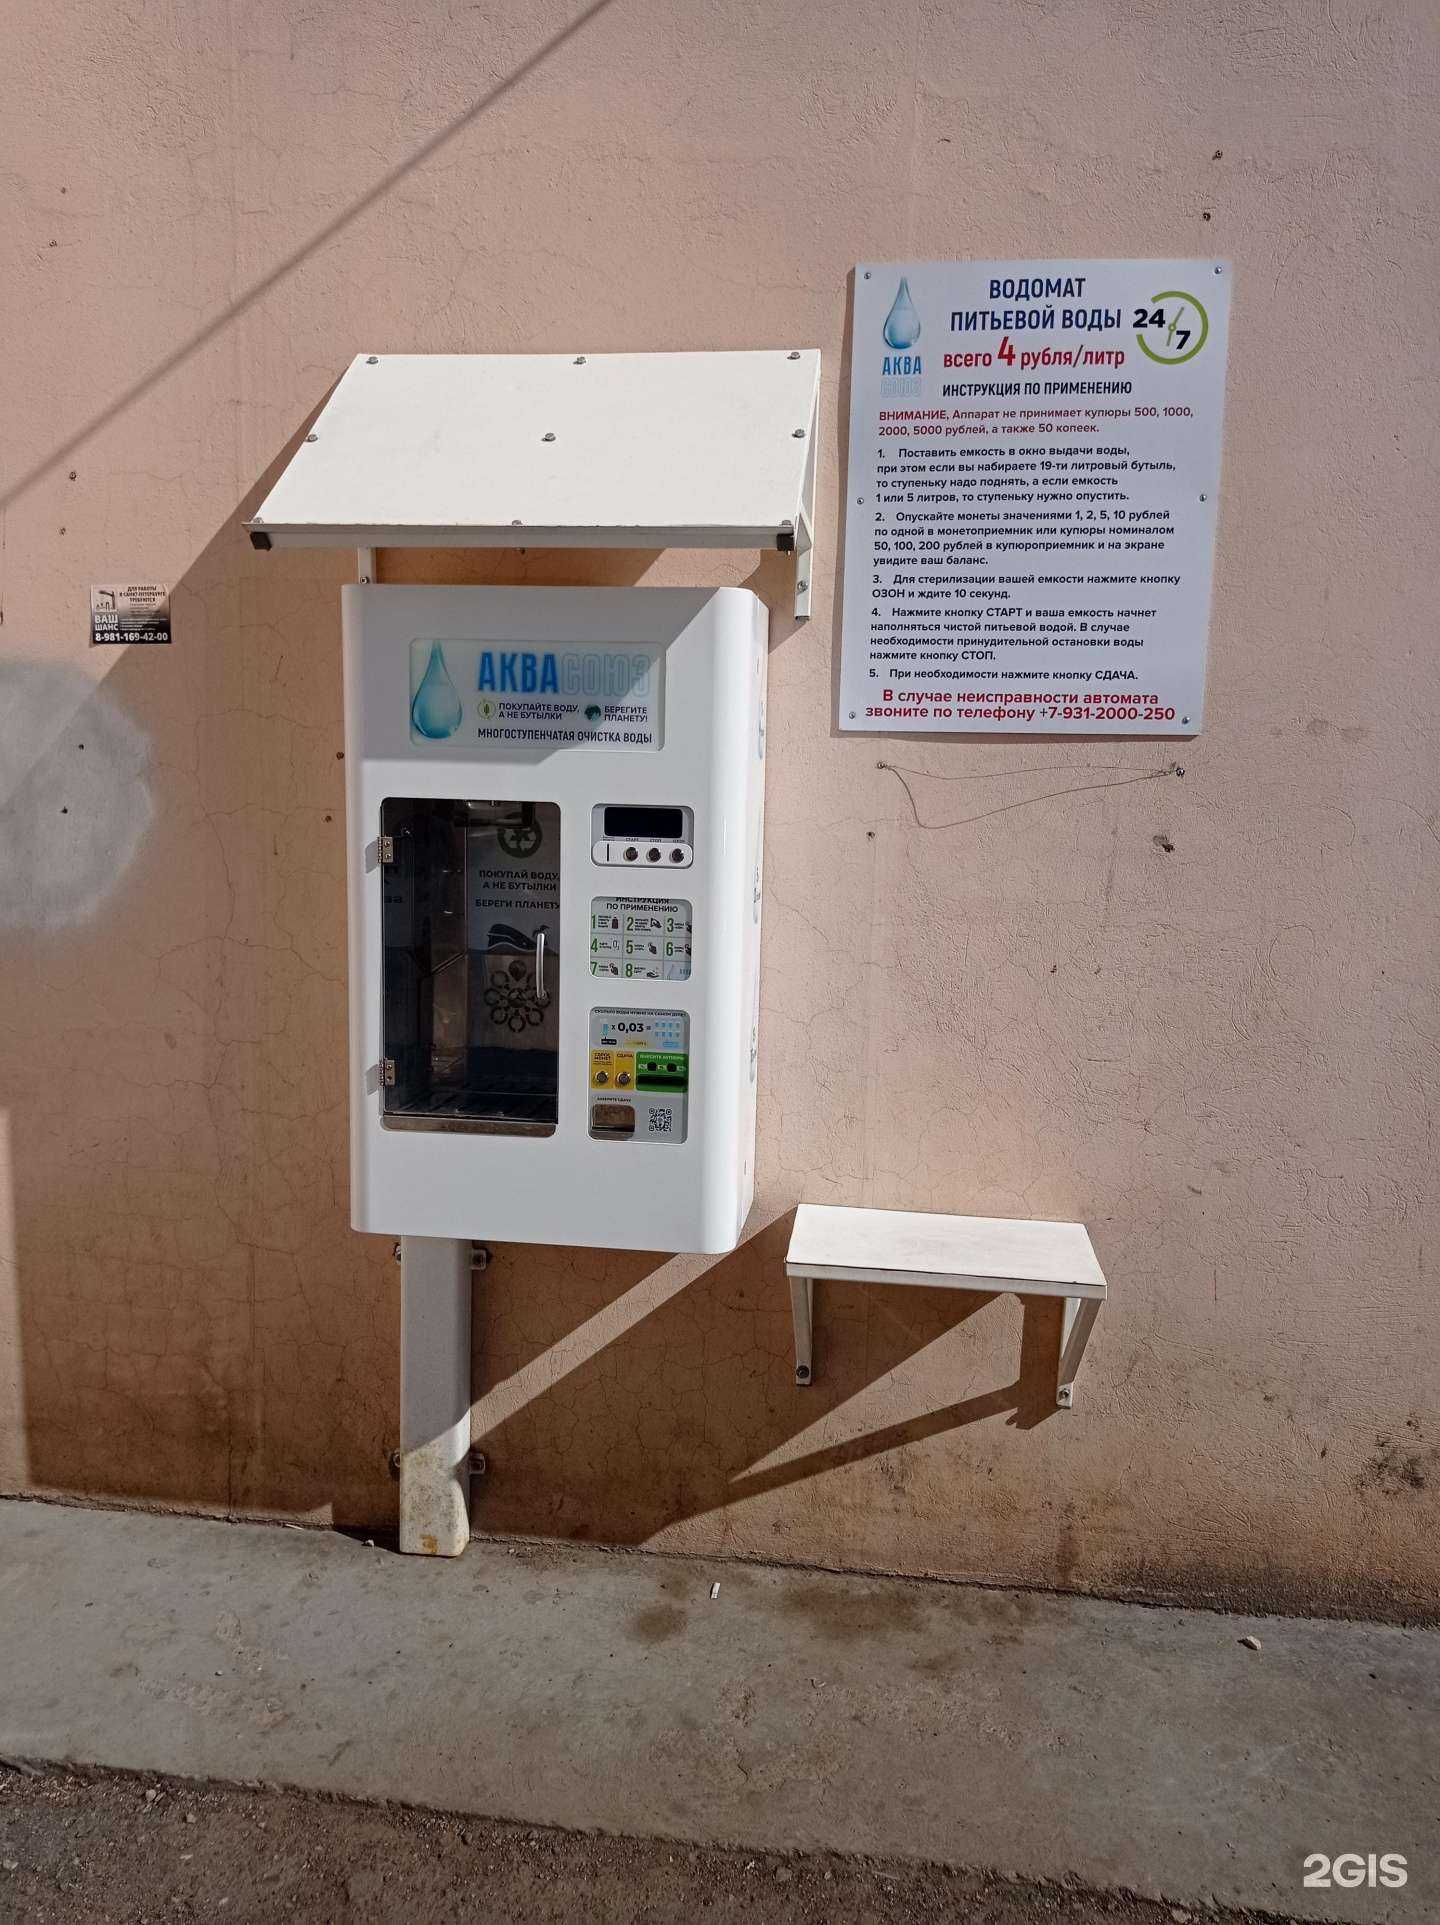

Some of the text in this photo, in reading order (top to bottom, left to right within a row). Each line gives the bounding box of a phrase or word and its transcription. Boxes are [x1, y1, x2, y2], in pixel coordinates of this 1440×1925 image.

[989, 277, 1086, 301] ВОДОМАТ
[950, 305, 1121, 331] ПИТЬЕВОЙ ВОДЫ
[1132, 309, 1190, 350] 24 7
[943, 336, 1124, 370] всего 4 рубля/литр
[882, 356, 922, 376] АКВА
[942, 381, 1132, 397] ИНСТРУКЦИЯ ПО ПРИМЕНЕНИЮ
[879, 406, 1193, 420] ВНИМАНИЕ, Аппарат не принимает купюры 500, 1000,
[878, 423, 1099, 437] 2000, 5000 рублей, также 50 копеек.
[898, 447, 1129, 457] Поставить емкость окно выдачи воды,
[877, 465, 897, 475] при
[928, 464, 955, 472] если
[977, 461, 1037, 473] набираете
[1039, 460, 1067, 470] 19-ти
[1070, 460, 1127, 472] литровый
[1130, 460, 1175, 472] бутыль,
[876, 477, 1118, 489] то ступеньку надо поднять, если емкость
[916, 494, 958, 503] литров,
[976, 493, 1034, 503] ступеньку
[1036, 493, 1073, 502] нужно
[1075, 492, 1129, 502] опустить.
[896, 511, 954, 523] Опускайте
[1002, 512, 1072, 520] значениями
[1113, 510, 1125, 519] 10
[1128, 510, 1169, 521] рублей
[874, 528, 887, 536] по
[890, 526, 924, 537] одной
[937, 527, 1033, 537] монетоприемник
[1060, 527, 1105, 536] купюры
[874, 541, 890, 551] 50,
[893, 540, 915, 551] 100,
[918, 540, 940, 550] 200
[942, 540, 982, 552] рублей
[995, 542, 1094, 552] купюроприемник
[1124, 541, 1164, 551] экране
[873, 557, 917, 567] увидите
[946, 555, 988, 564] баланс.
[893, 574, 1180, 585] Для стерилизации вашей емкости нажмите кнопку
[872, 588, 1010, 600] ОЗОН ждите 10 секунд.
[95, 615, 118, 623] ВАШ
[891, 607, 1156, 619] Нажмите кнопку СТАРТ ваша емкость начнет
[871, 622, 1129, 633] наполняться чистой питьевой водой. случае
[96, 632, 168, 641] 8-981-169-42-00
[870, 635, 1143, 647] необходимости принудительной остановки воды
[920, 652, 958, 662] кнопку
[961, 650, 995, 660] СТОП.
[889, 668, 1138, 681] При необходимости нажмите кнопку СДАЧА.
[898, 692, 1158, 705] случае неисправности автомата
[498, 702, 552, 712] ПОКУПАЙТЕ
[604, 706, 647, 714] БЕРЕГИТЕ
[520, 712, 562, 720] БУТЫЛКИ
[604, 714, 648, 723] ПЛАНЕТУ!
[865, 706, 1175, 721] звоните по телефону +7-931-2000-250
[478, 729, 652, 744] МНОГОСТУПЕНЧАТАЯ ОЧИСТКА ВОДЫ
[480, 870, 528, 879] ПОКУПАЙ
[508, 882, 556, 890] БУТЫЛКИ
[475, 899, 512, 908] БЕРЕГИ
[621, 904, 678, 912] ПРИМЕНЕНИЮ
[591, 914, 596, 929] 1
[627, 917, 634, 931] 2
[667, 918, 674, 932] 3
[591, 939, 598, 953] 4
[626, 940, 633, 954] 5
[666, 942, 673, 956] 6
[591, 962, 597, 975] 7
[626, 964, 633, 978] 8
[618, 1022, 644, 1033] 0,03
